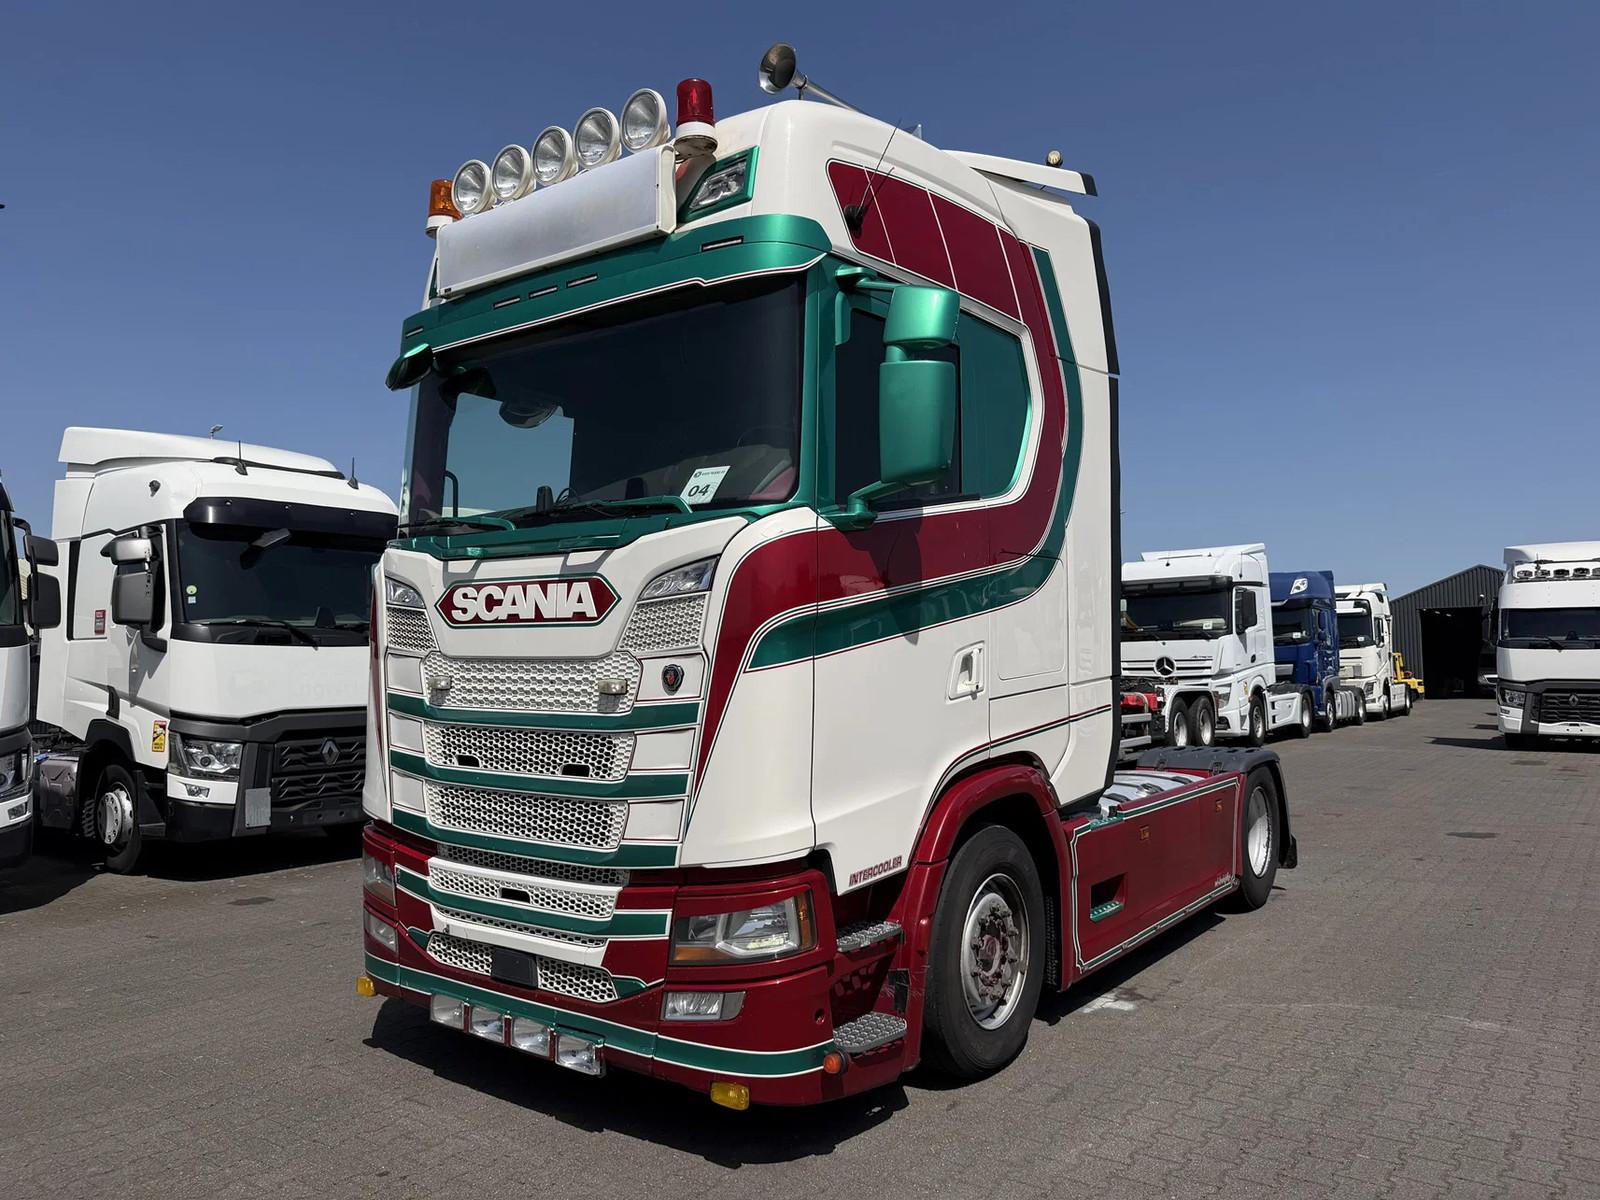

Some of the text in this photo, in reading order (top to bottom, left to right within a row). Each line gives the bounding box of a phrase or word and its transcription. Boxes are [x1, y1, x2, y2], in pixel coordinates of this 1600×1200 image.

[688, 484, 711, 497] 04
[451, 581, 598, 622] SCANIA
[848, 855, 903, 887] INTERCOOLER
